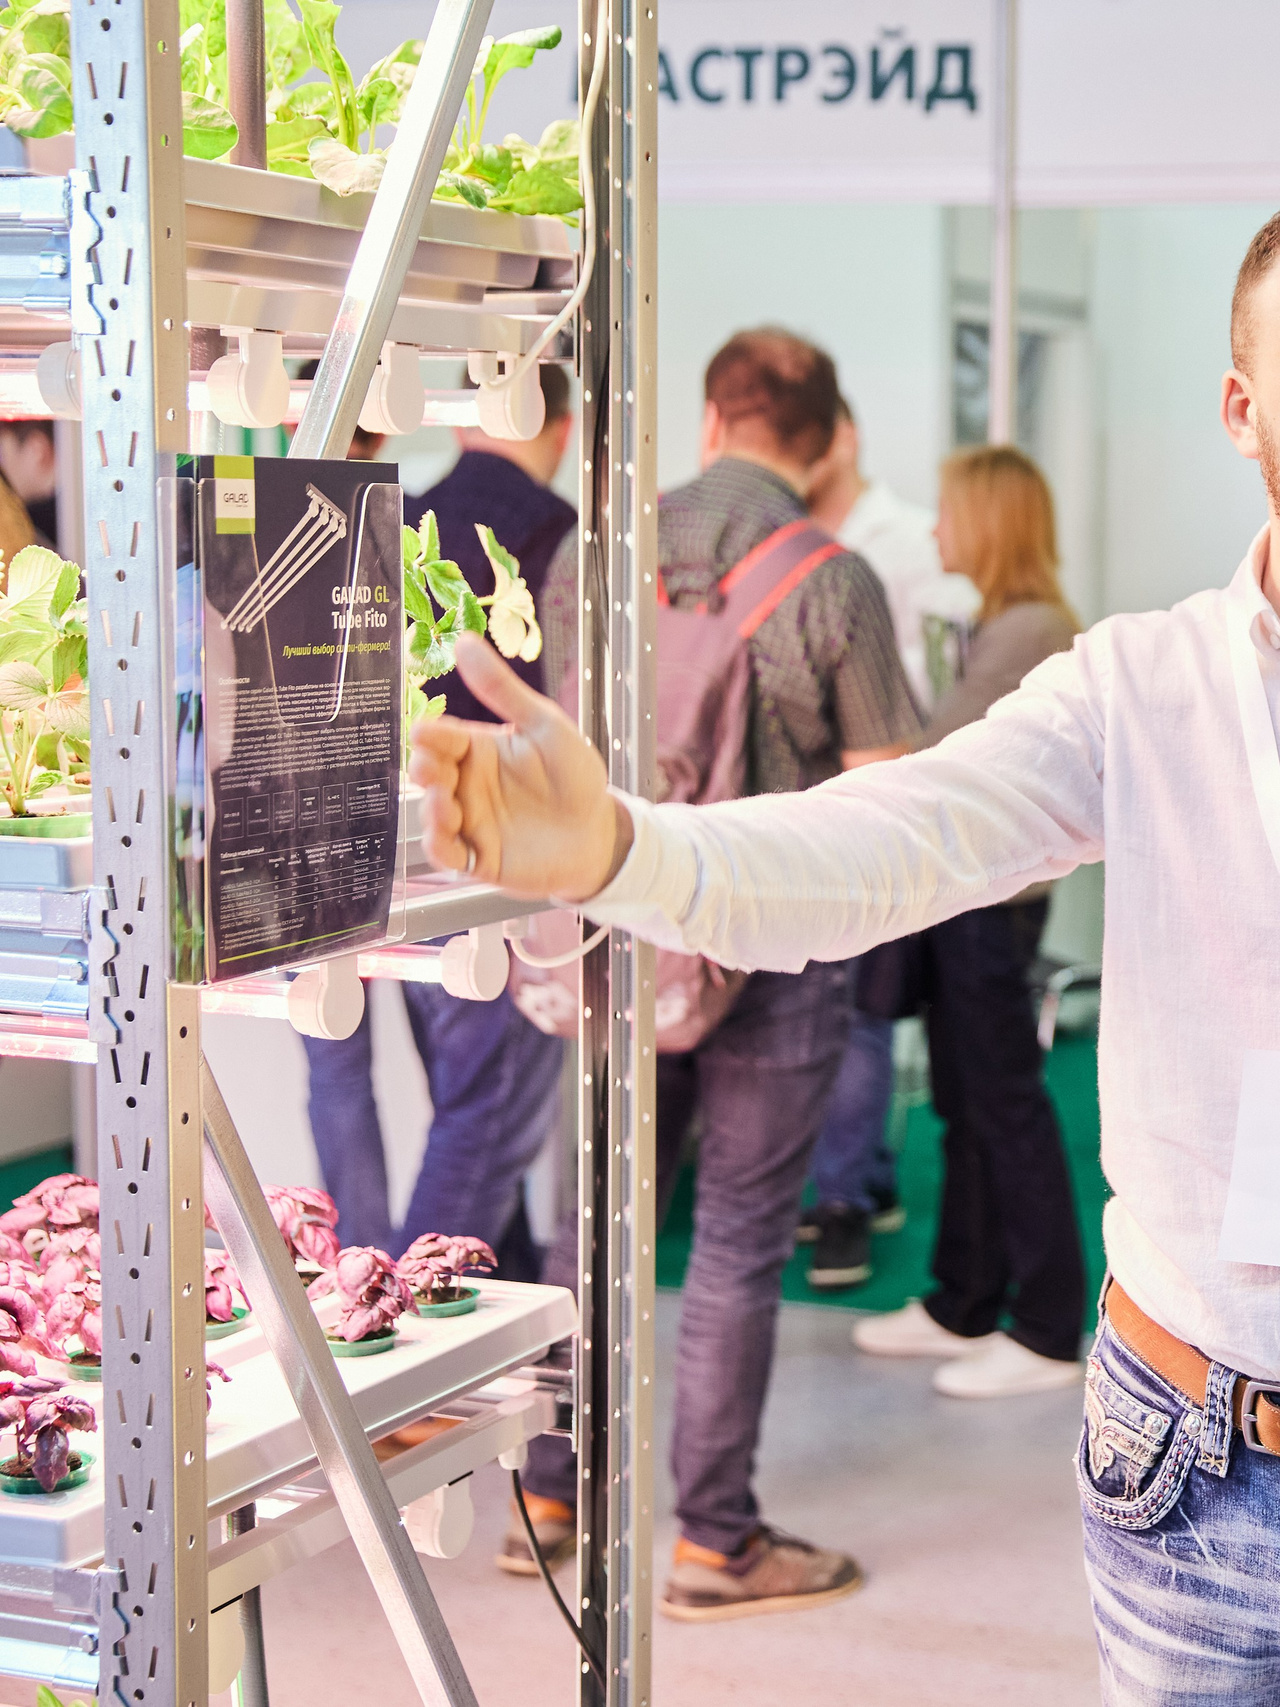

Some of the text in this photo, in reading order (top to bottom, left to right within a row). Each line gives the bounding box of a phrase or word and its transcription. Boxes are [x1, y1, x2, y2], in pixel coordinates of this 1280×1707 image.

[572, 29, 979, 113] АСТРЭЙД
[223, 493, 249, 503] GALAD
[332, 585, 390, 605] GALAD GL
[331, 607, 388, 629] Tube Fito
[282, 643, 312, 659] Лучший
[312, 643, 336, 656] выбор
